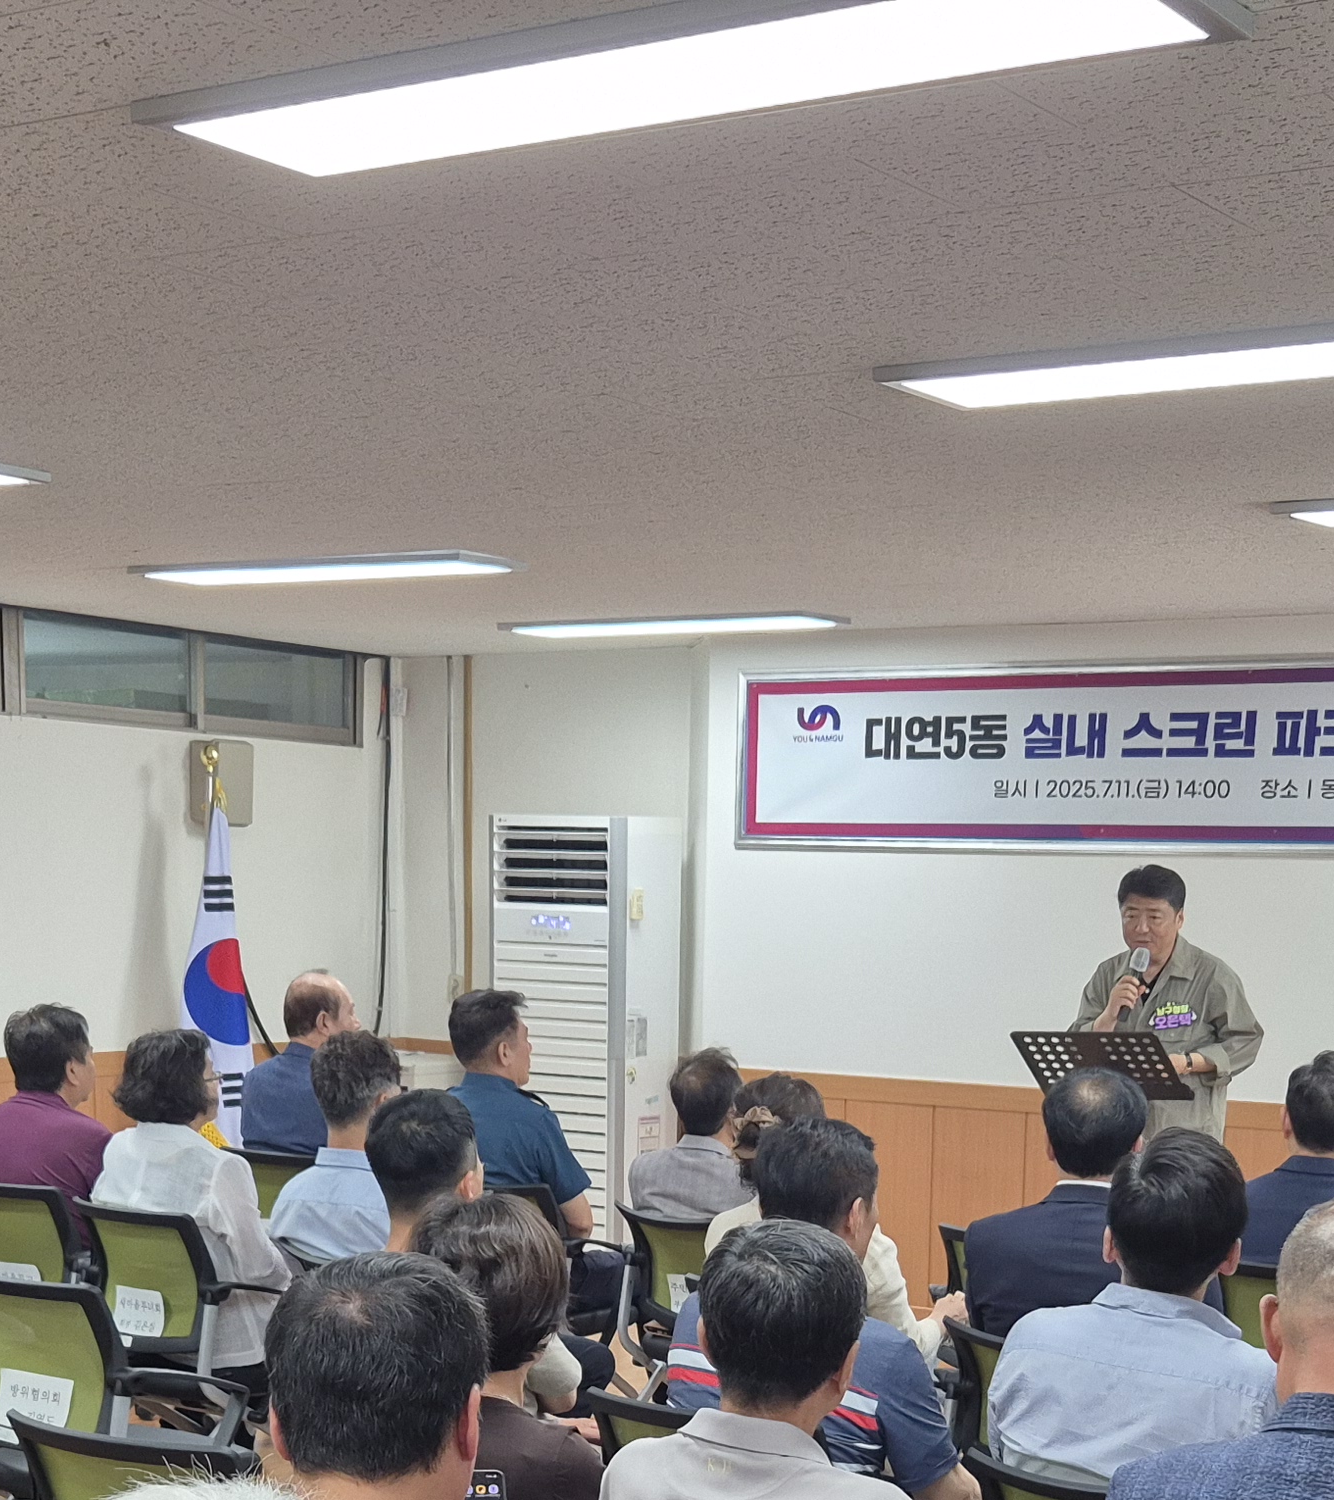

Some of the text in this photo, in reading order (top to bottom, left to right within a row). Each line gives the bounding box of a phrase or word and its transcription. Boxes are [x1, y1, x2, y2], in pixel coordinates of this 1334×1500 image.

[864, 713, 1008, 761] 대연5동
[1023, 712, 1108, 760] 실내
[1120, 709, 1258, 759] 스크린
[993, 779, 1028, 799] 일시
[1046, 778, 1170, 800] 2025.7.11.(금)
[1175, 779, 1231, 799] 14:00
[1260, 778, 1299, 800] 장소
